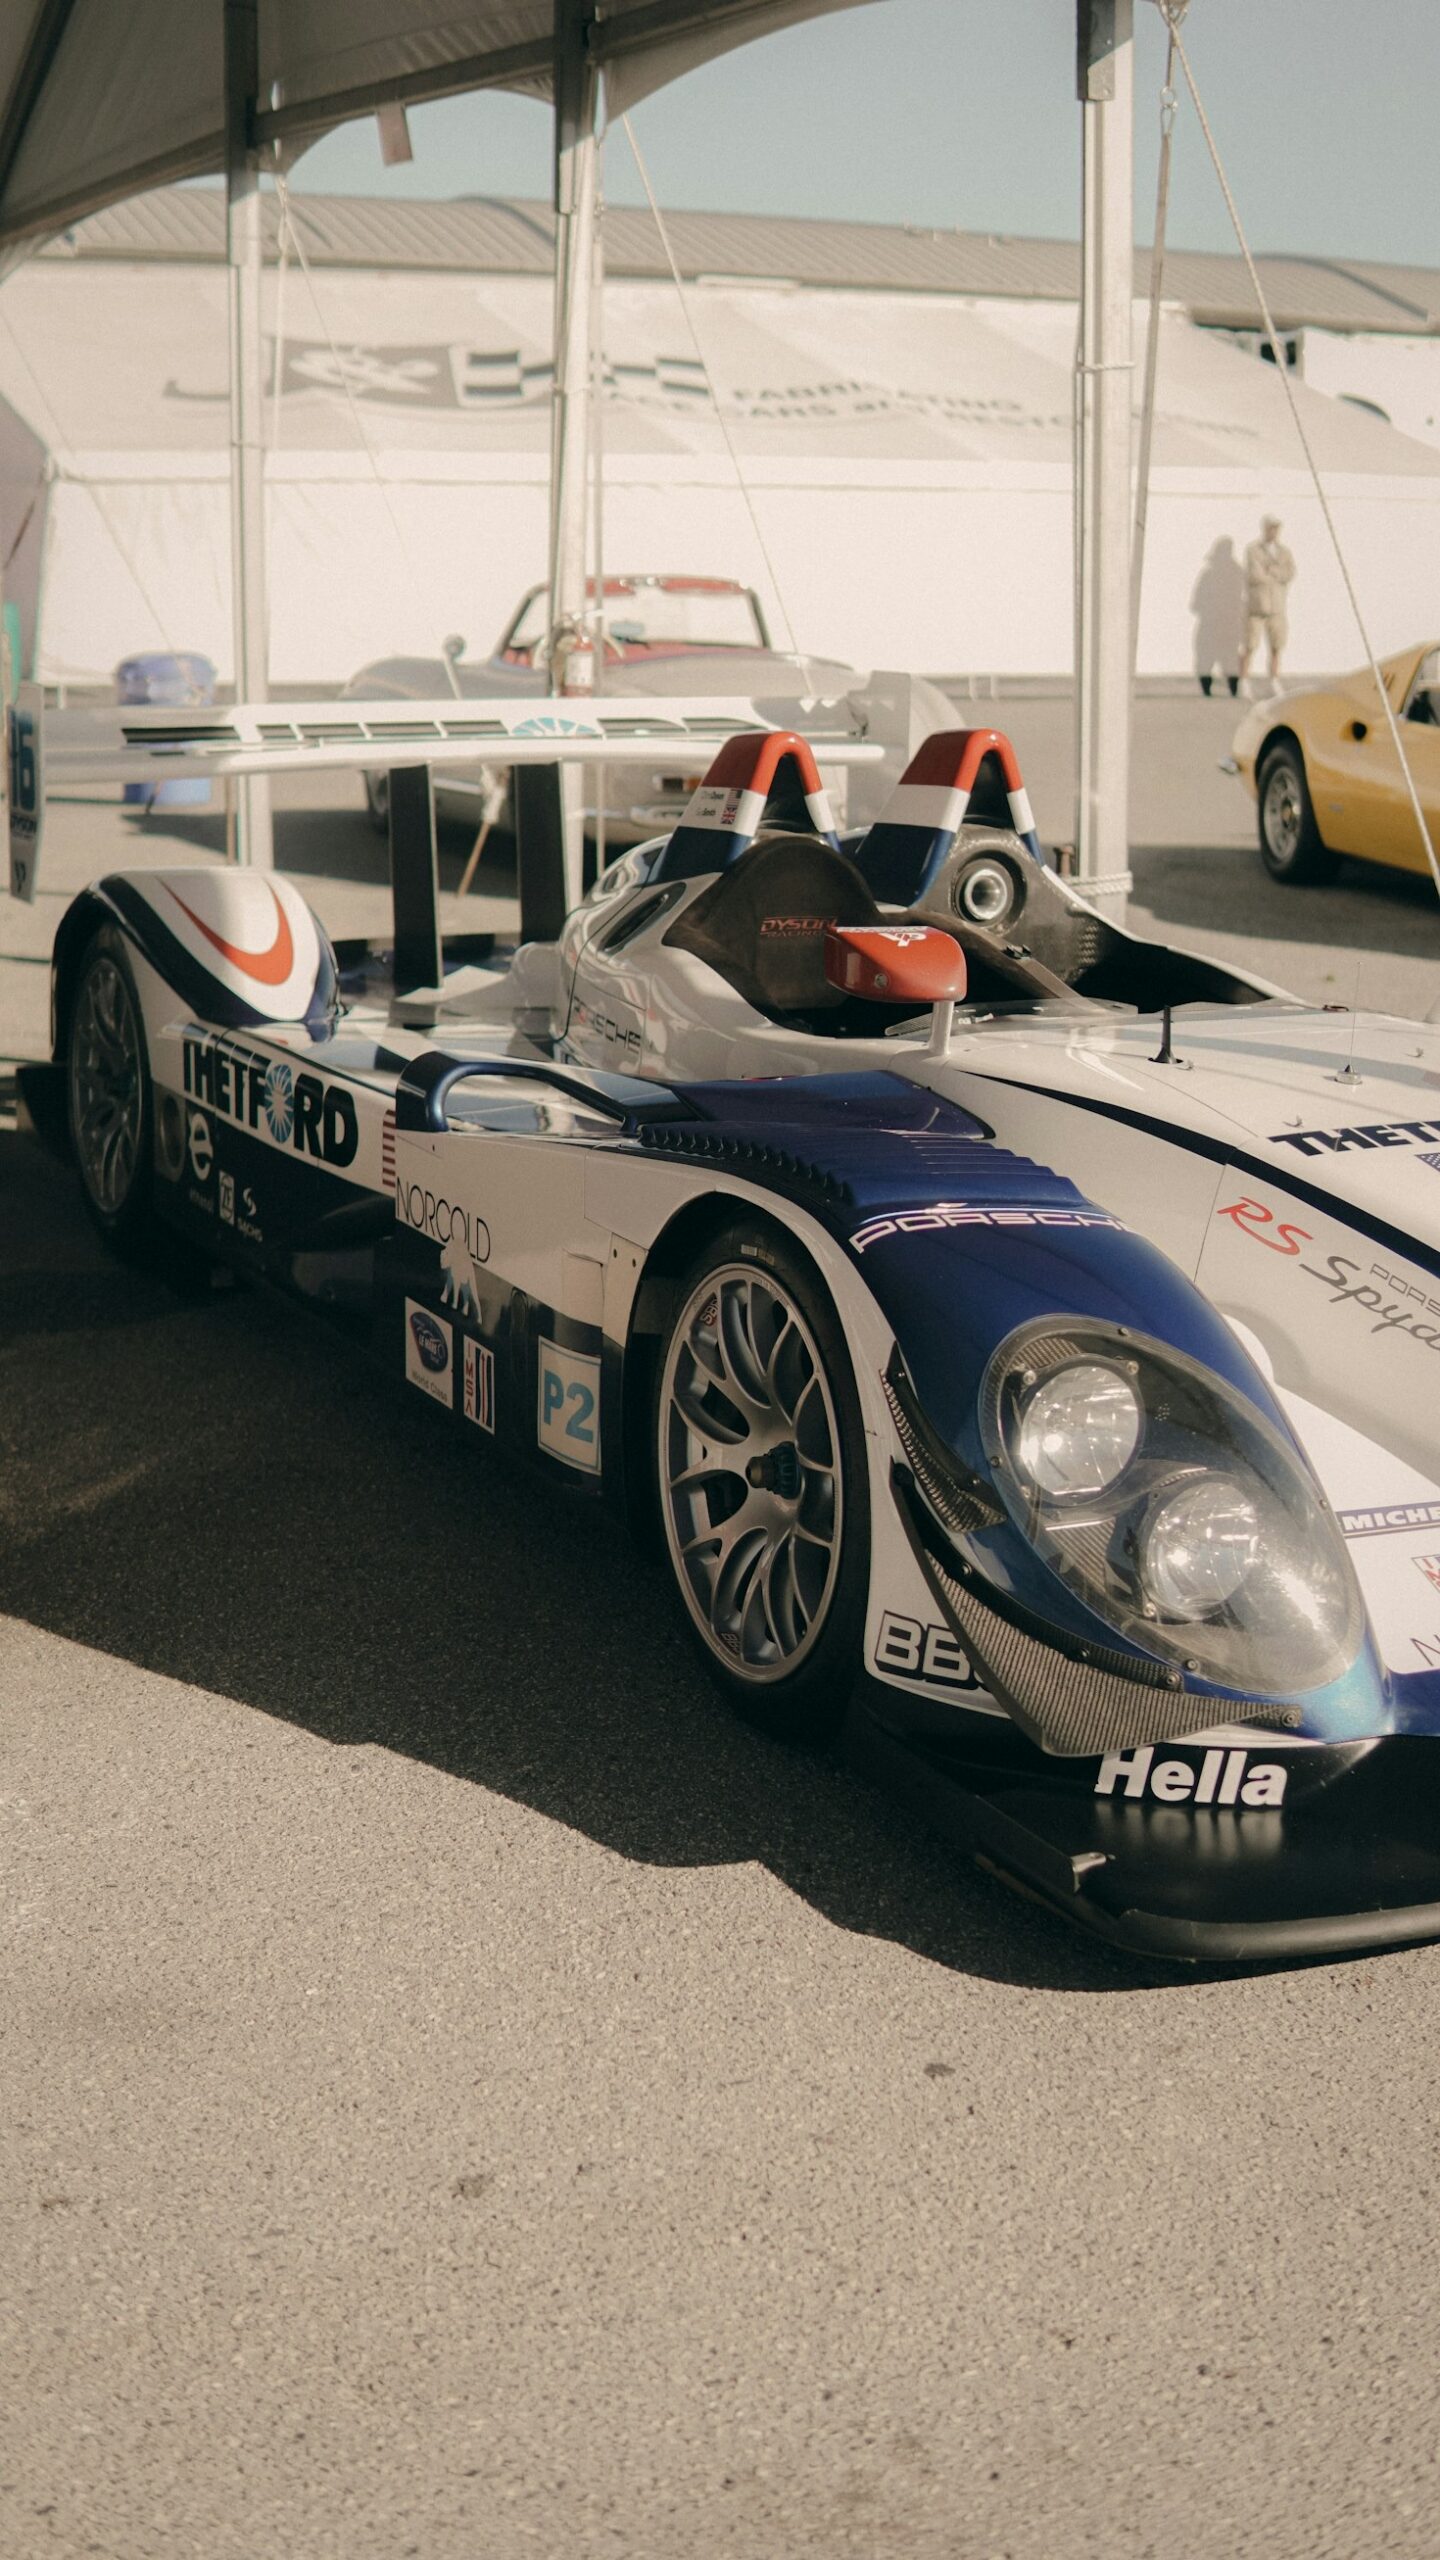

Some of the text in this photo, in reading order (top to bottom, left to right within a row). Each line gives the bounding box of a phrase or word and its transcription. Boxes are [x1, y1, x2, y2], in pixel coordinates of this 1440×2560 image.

[760, 917, 839, 932] DYSON
[1265, 1120, 1440, 1157] THET
[396, 1175, 491, 1264] NORCOLD
[1217, 1196, 1314, 1256] RS
[543, 1368, 595, 1443] P2
[874, 1609, 993, 1693] BB
[1094, 1746, 1288, 1807] Hella
